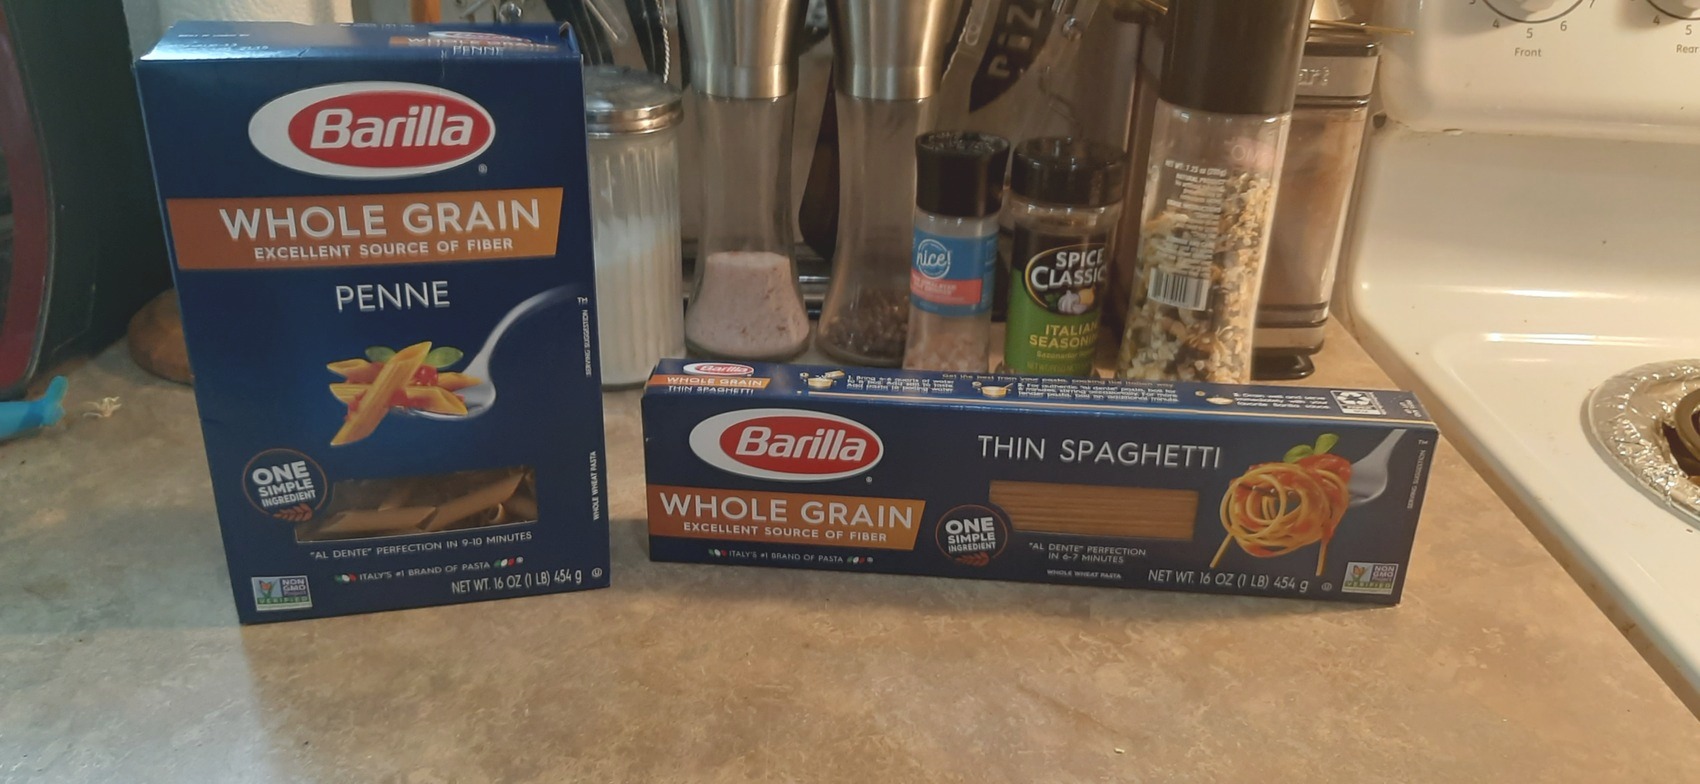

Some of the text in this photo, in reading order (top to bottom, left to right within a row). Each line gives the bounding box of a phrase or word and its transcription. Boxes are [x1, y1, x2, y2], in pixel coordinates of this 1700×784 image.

[1493, 19, 1500, 29] 4
[1560, 20, 1567, 31] 6
[1652, 14, 1660, 25] 4
[1526, 28, 1533, 38] 5
[1685, 24, 1692, 35] 5
[1514, 47, 1542, 57] Front
[1676, 43, 1699, 53] Rear
[310, 105, 474, 149] Barilla
[219, 199, 540, 240] WHOLE GRAIN
[254, 237, 513, 261] EXCELLENT SOURCE OF FIBER
[1055, 246, 1104, 267] SPICE
[916, 249, 951, 266] nice!
[336, 280, 451, 312] PENNE
[1045, 321, 1098, 336] ITALIAN
[699, 364, 748, 372] Barilla
[666, 376, 762, 387] WHOLE GRAIN
[696, 386, 754, 395] SPAGHETTI
[735, 425, 868, 462] Barilla
[977, 434, 1222, 469] THIN SPAGHETTI
[252, 460, 310, 485] ONE
[258, 478, 314, 497] SIMPLE
[589, 450, 600, 520] WHOLE WHEAT PASTA
[261, 489, 316, 507] INGREDIENT
[659, 492, 914, 530] WHOLE GRAIN
[683, 521, 887, 543] EXCELLENT SOURCE OF FIBER
[945, 516, 995, 534] ONE
[332, 547, 373, 558] DENTE"
[376, 542, 442, 554] PERFECTION
[446, 540, 457, 548] IN
[461, 537, 482, 546] 9-10
[485, 530, 533, 543] MINUTES
[947, 531, 996, 543] SIMPLE
[948, 541, 996, 552] INGREDIENT
[1048, 543, 1083, 552] DENTE"
[1086, 545, 1146, 556] PERFECTION
[729, 550, 757, 558] ITALY'S
[771, 551, 801, 560] BRAND
[818, 554, 844, 562] PASTA
[1048, 551, 1124, 563] IN 6-7 MINUTES
[359, 570, 393, 580] ITALY'S
[408, 565, 442, 575] BRAND
[461, 560, 491, 570] PASTA
[1046, 568, 1121, 579] WHOLE WHEAT PASTA
[451, 568, 582, 594] NET WT. 16 OZ (1 LB) 454 g
[1148, 569, 1309, 593] NET WT. 16 OZ (1 LB) 454 g
[1346, 580, 1391, 589] VERIFIED
[257, 595, 307, 604] VERIFIED
